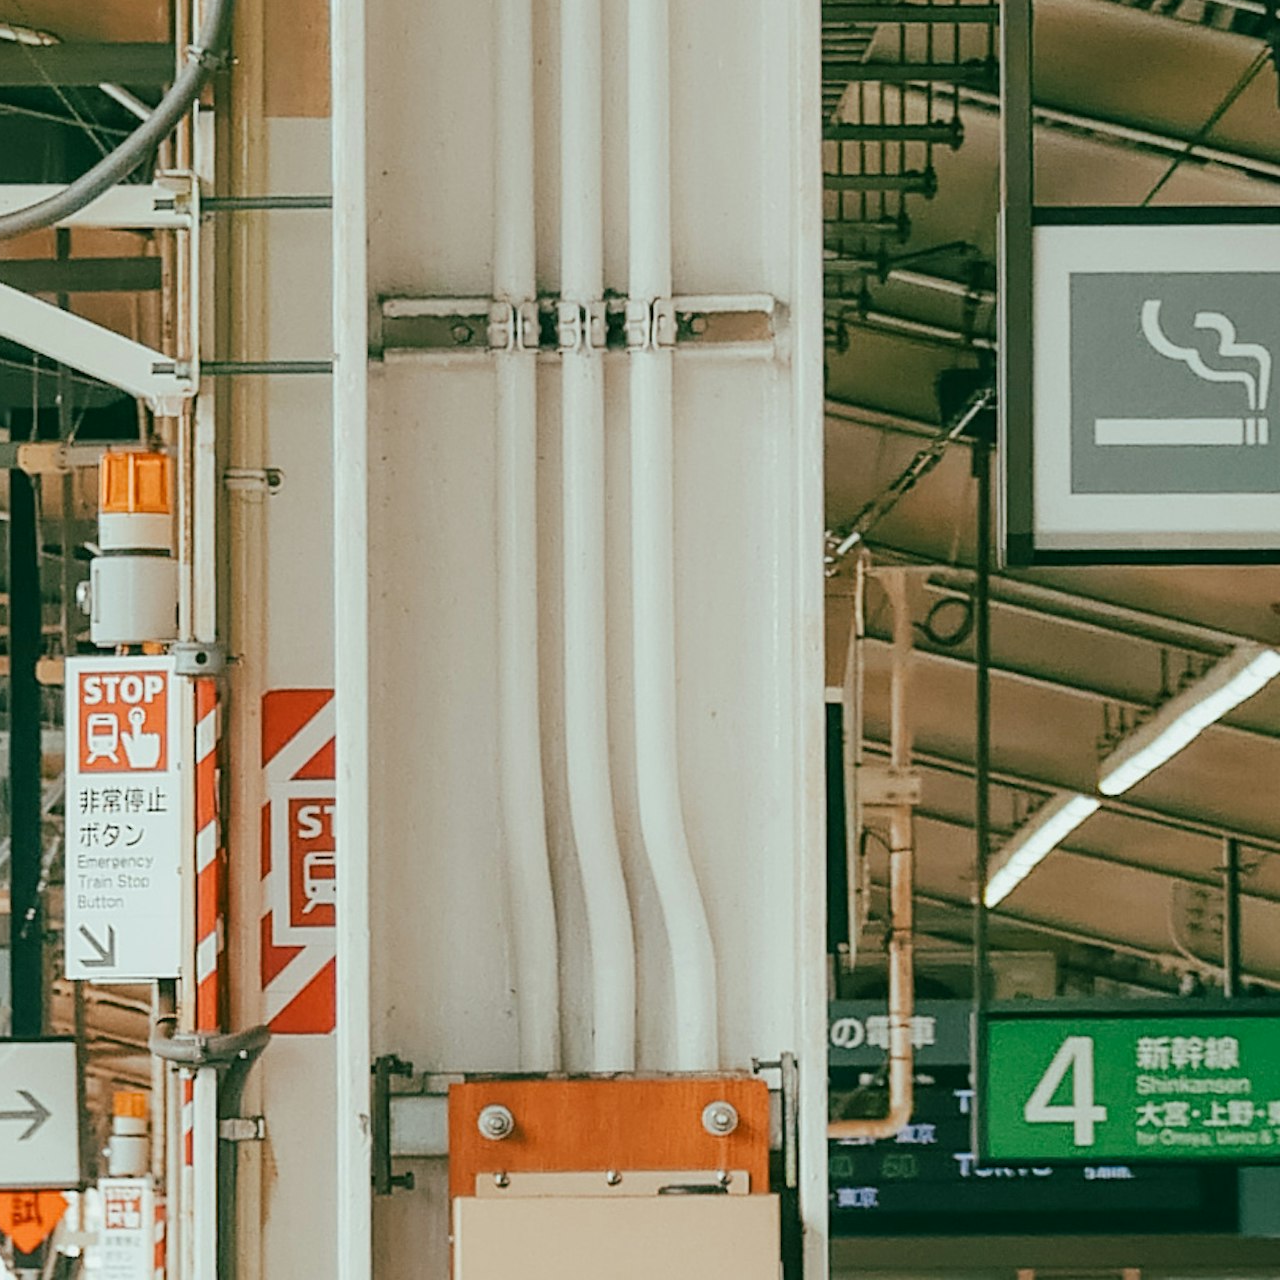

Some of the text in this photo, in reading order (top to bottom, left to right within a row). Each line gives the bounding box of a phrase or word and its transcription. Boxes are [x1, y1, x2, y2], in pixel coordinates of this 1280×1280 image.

[83, 675, 164, 704] STOP
[78, 787, 168, 815] 非常停止
[78, 823, 145, 848] ボタン
[77, 855, 154, 871] Emergency
[77, 873, 150, 890] Train Stop
[77, 895, 125, 910] Button
[1136, 1036, 1240, 1071] 新幹線
[1024, 1036, 1107, 1147] 4
